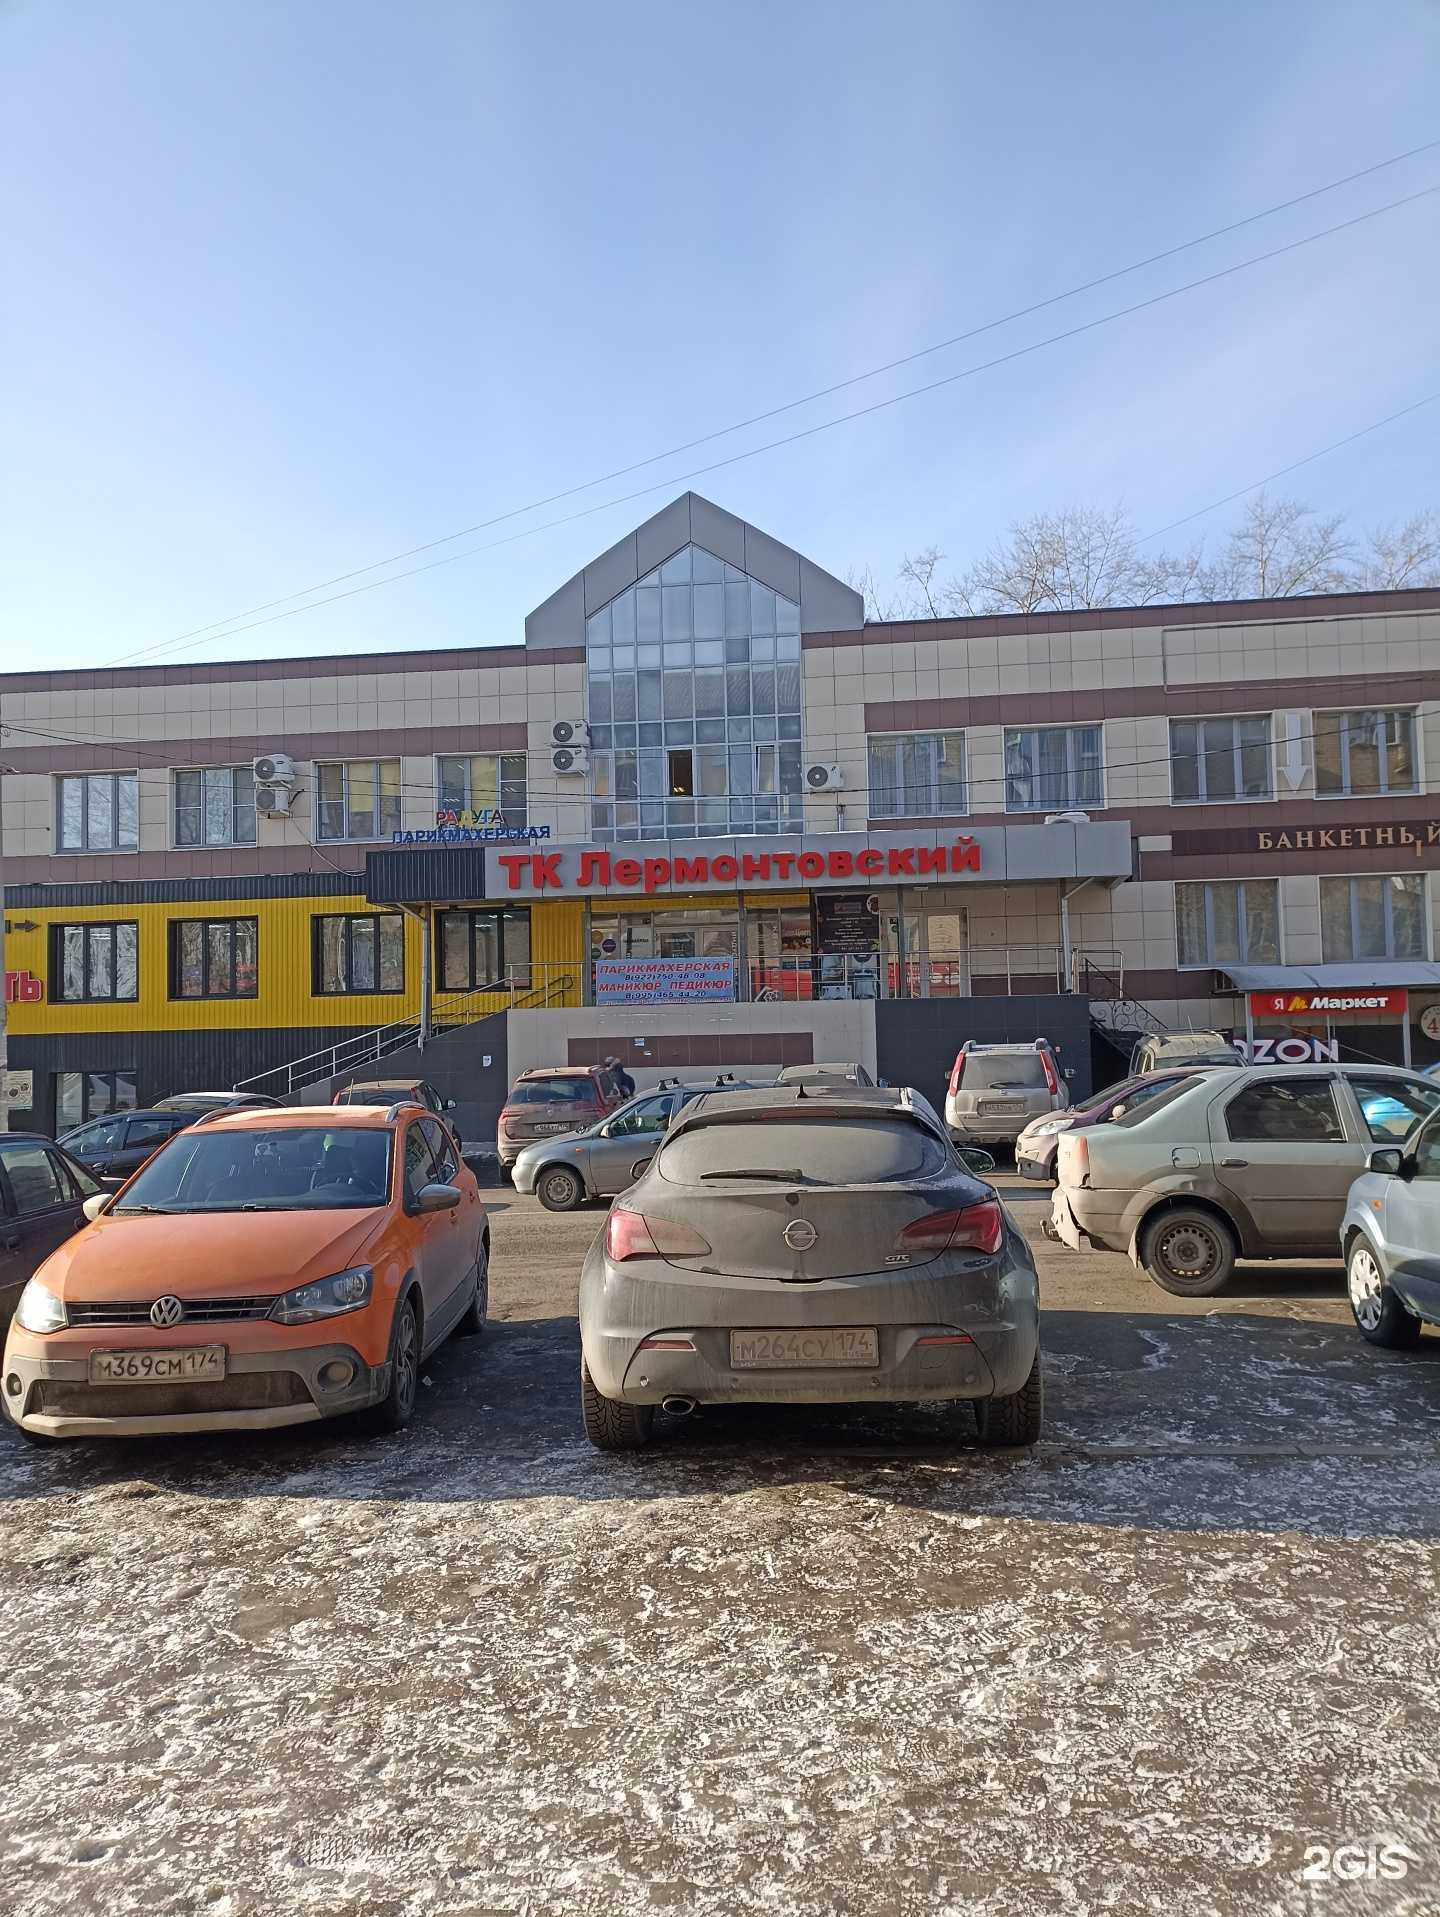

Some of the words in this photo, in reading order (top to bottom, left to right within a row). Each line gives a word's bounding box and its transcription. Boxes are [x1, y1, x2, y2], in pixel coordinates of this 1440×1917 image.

[436, 809, 505, 827] РАДУГА
[392, 825, 551, 844] ПАРИКМАХЕРСКАЯ
[498, 853, 563, 890] ТК
[576, 836, 981, 892] Лермонтовский
[600, 962, 731, 974] ПАРИКМАХЕРСКАЯ
[597, 982, 662, 992] МАНИКЮР
[670, 980, 732, 990] ПЕДИКЮР
[1274, 998, 1284, 1010] Я
[1309, 996, 1389, 1011] Маркет
